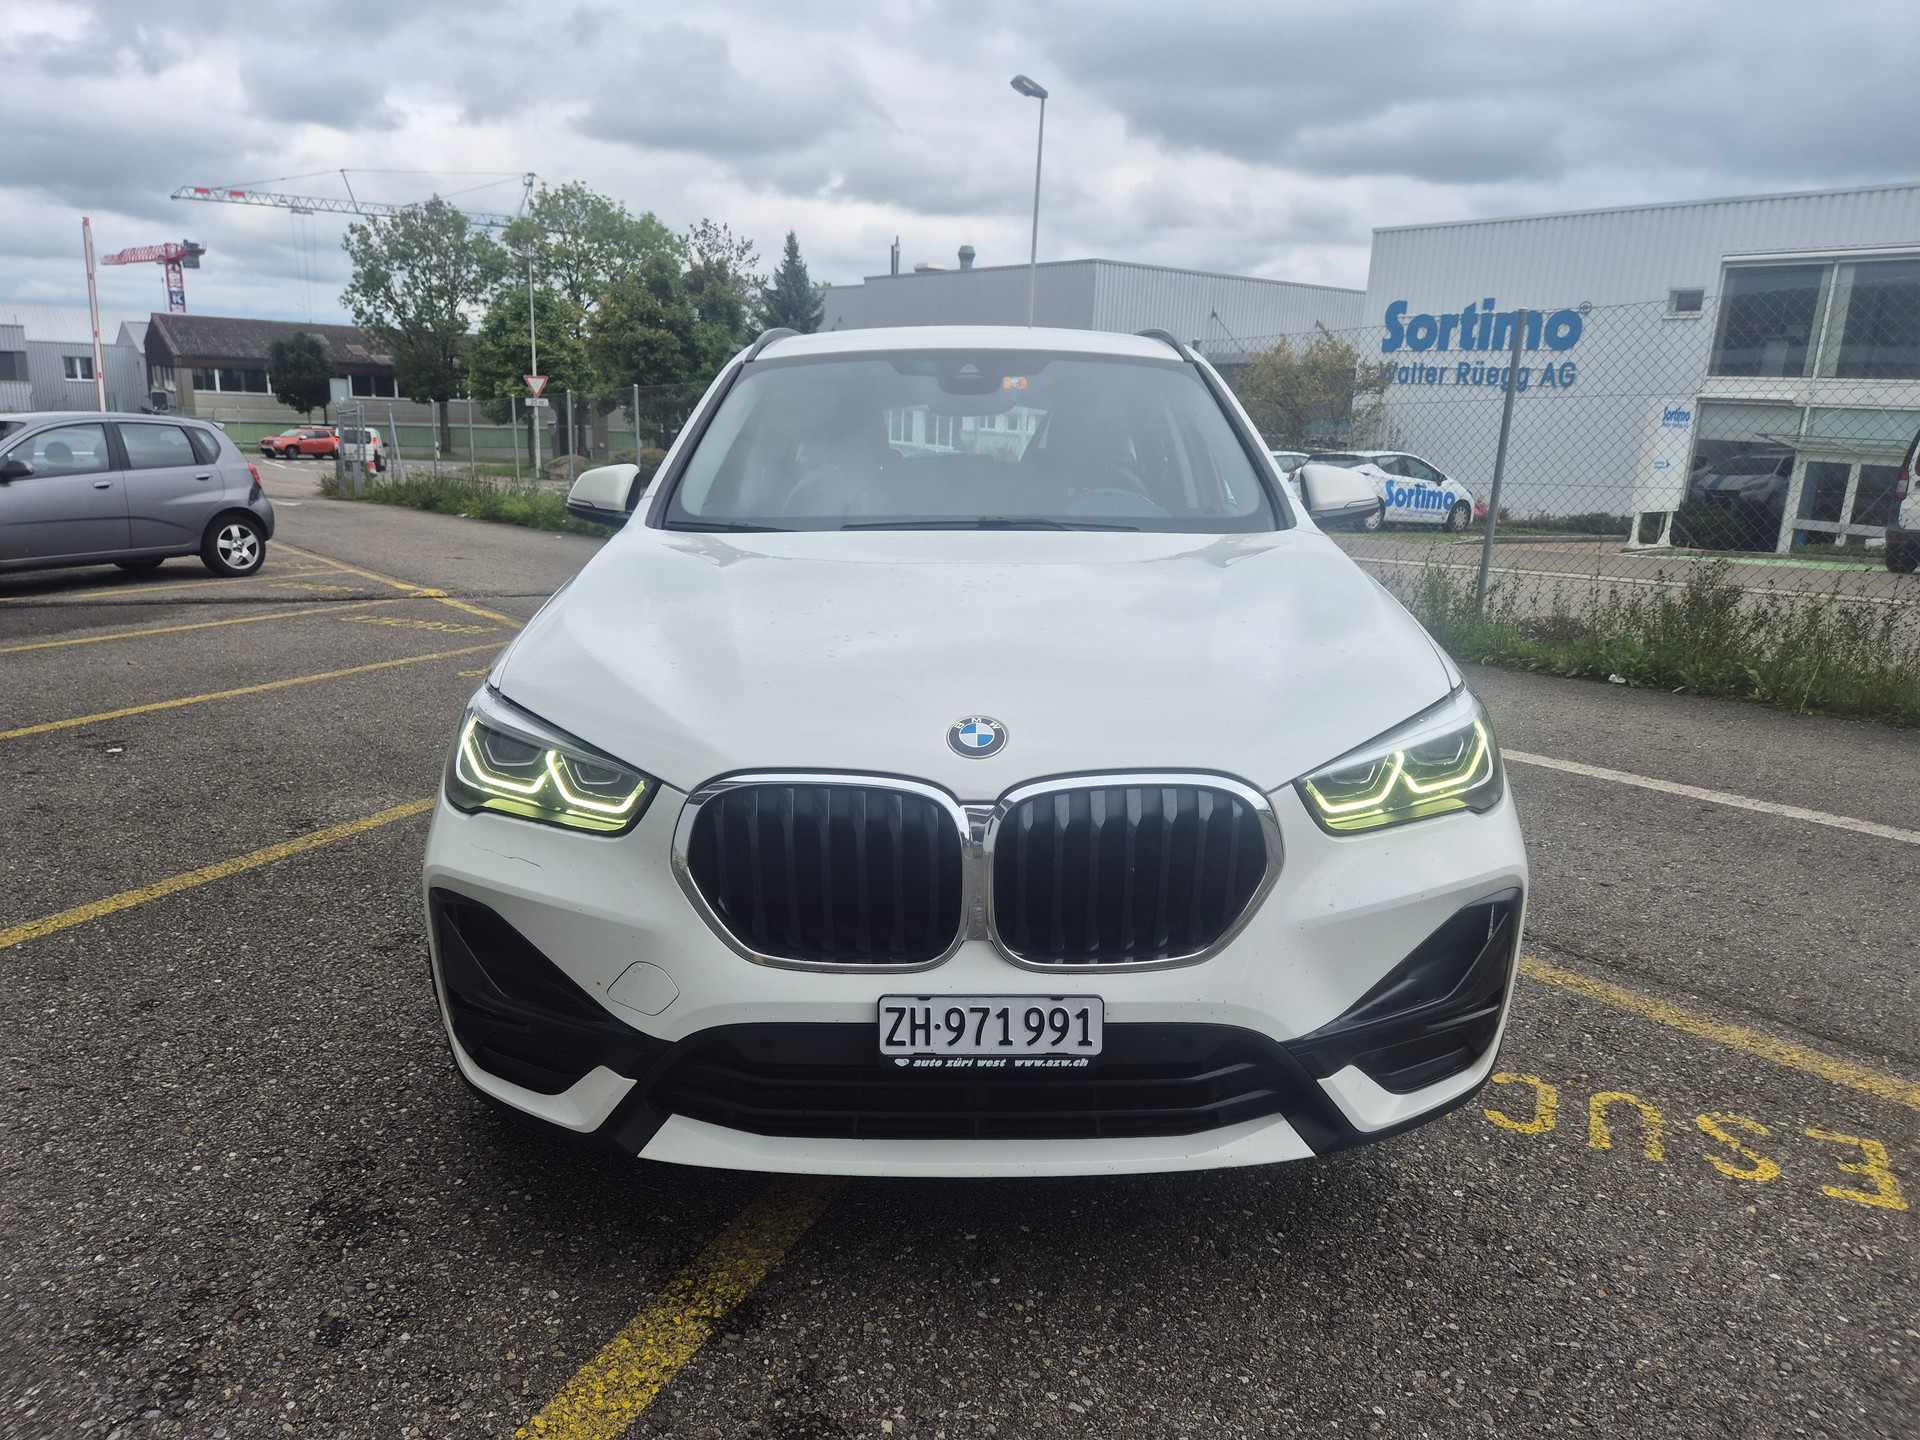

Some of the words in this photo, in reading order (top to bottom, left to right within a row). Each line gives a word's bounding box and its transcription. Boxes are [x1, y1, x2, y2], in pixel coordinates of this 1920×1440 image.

[1539, 361, 1577, 388] AG
[1385, 479, 1455, 510] Sortimo
[913, 1058, 942, 1067] auto
[976, 1058, 1006, 1067] west
[1014, 1057, 1089, 1067] www.azw.ch
